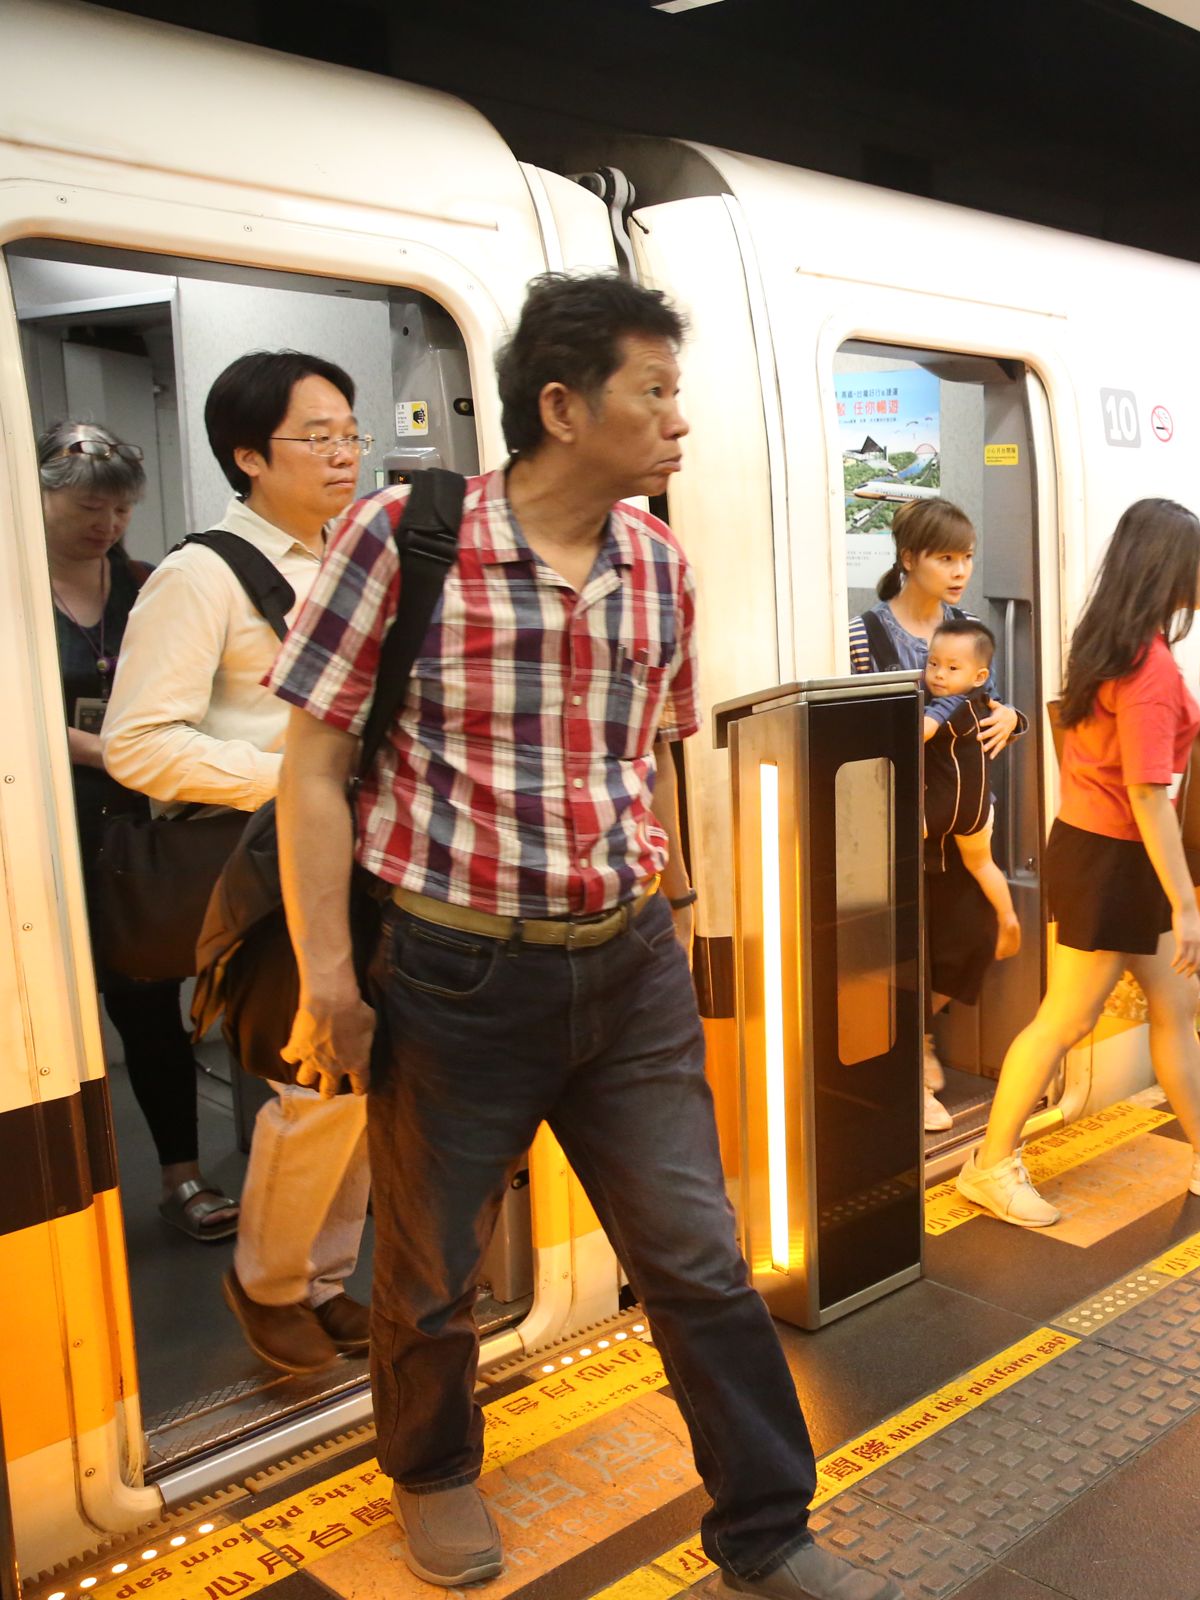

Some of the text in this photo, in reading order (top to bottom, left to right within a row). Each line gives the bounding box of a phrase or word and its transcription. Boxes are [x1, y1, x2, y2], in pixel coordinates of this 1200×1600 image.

[1105, 395, 1138, 441] 10
[888, 1411, 938, 1442] Mind
[935, 1393, 968, 1414] the
[967, 1353, 1038, 1397] platform
[1036, 1334, 1067, 1355] gap
[116, 1483, 357, 1599] the platform gap
